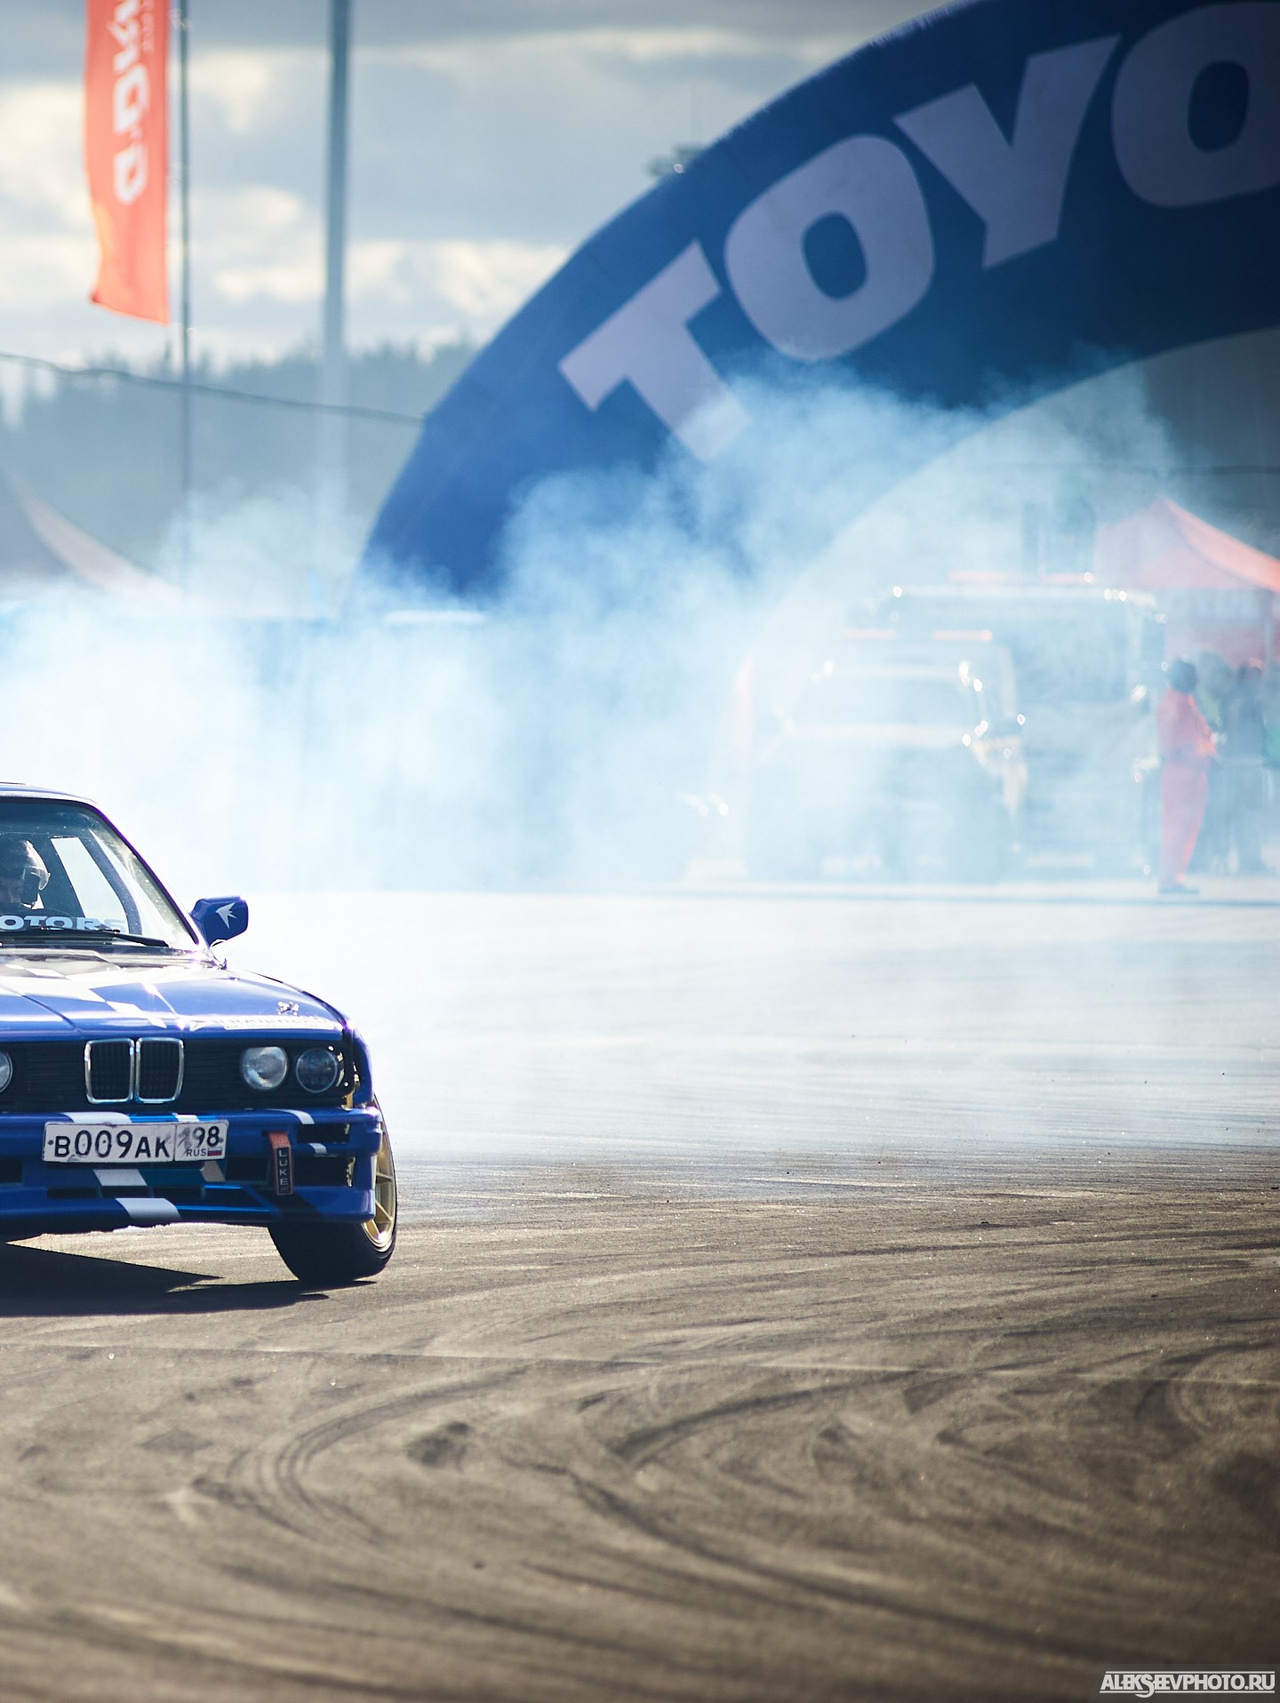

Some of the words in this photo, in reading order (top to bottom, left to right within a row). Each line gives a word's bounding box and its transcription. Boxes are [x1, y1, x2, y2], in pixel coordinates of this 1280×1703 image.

[558, 0, 1280, 463] TOYO
[53, 1129, 171, 1159] B009AK
[186, 1148, 207, 1157] RUS
